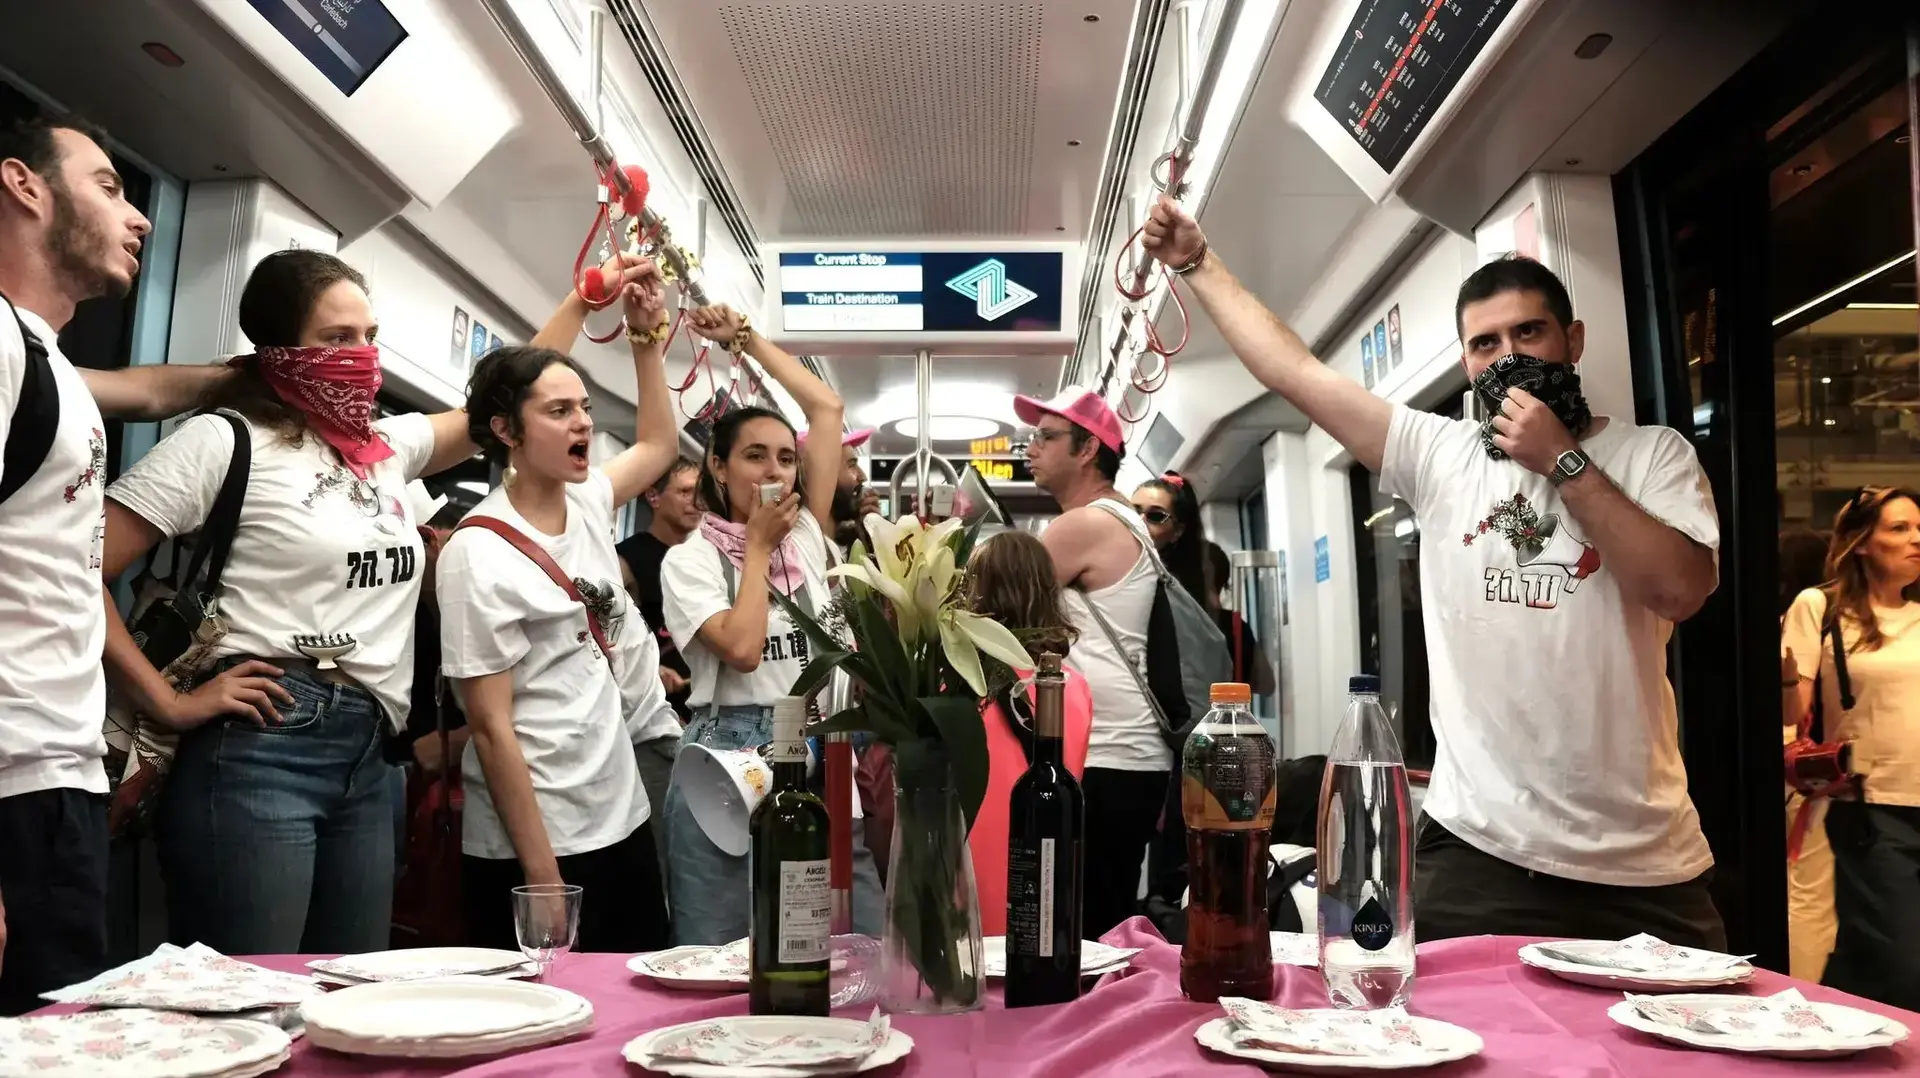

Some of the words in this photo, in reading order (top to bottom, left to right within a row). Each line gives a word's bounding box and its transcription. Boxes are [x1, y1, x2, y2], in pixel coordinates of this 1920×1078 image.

[320, 0, 348, 29] Carlebach
[814, 253, 858, 266] Current
[858, 253, 887, 266] Stop
[806, 293, 834, 304] Train
[835, 293, 899, 304] Destination
[1354, 923, 1391, 933] KINLEY
